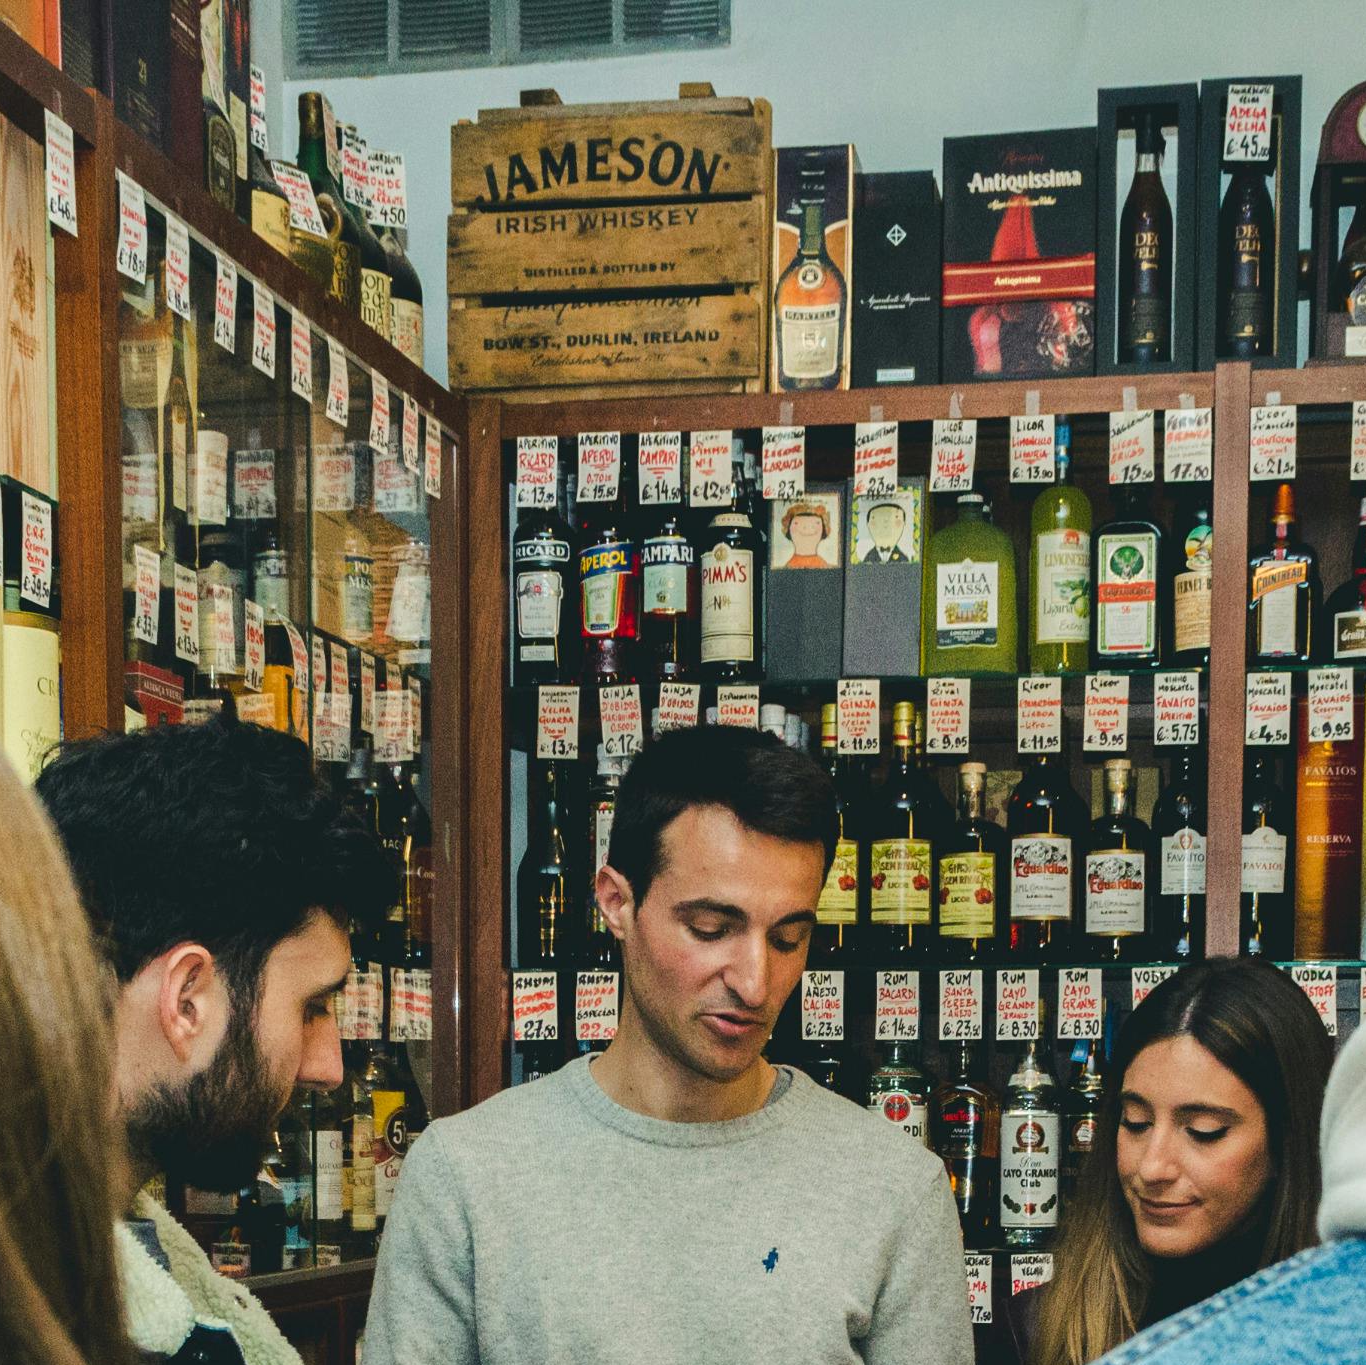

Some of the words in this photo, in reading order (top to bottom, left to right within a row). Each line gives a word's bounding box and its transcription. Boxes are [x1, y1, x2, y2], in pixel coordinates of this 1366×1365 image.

[477, 139, 722, 205] JAMESON
[497, 215, 567, 235] IRISH
[578, 209, 700, 234] WHISKEY
